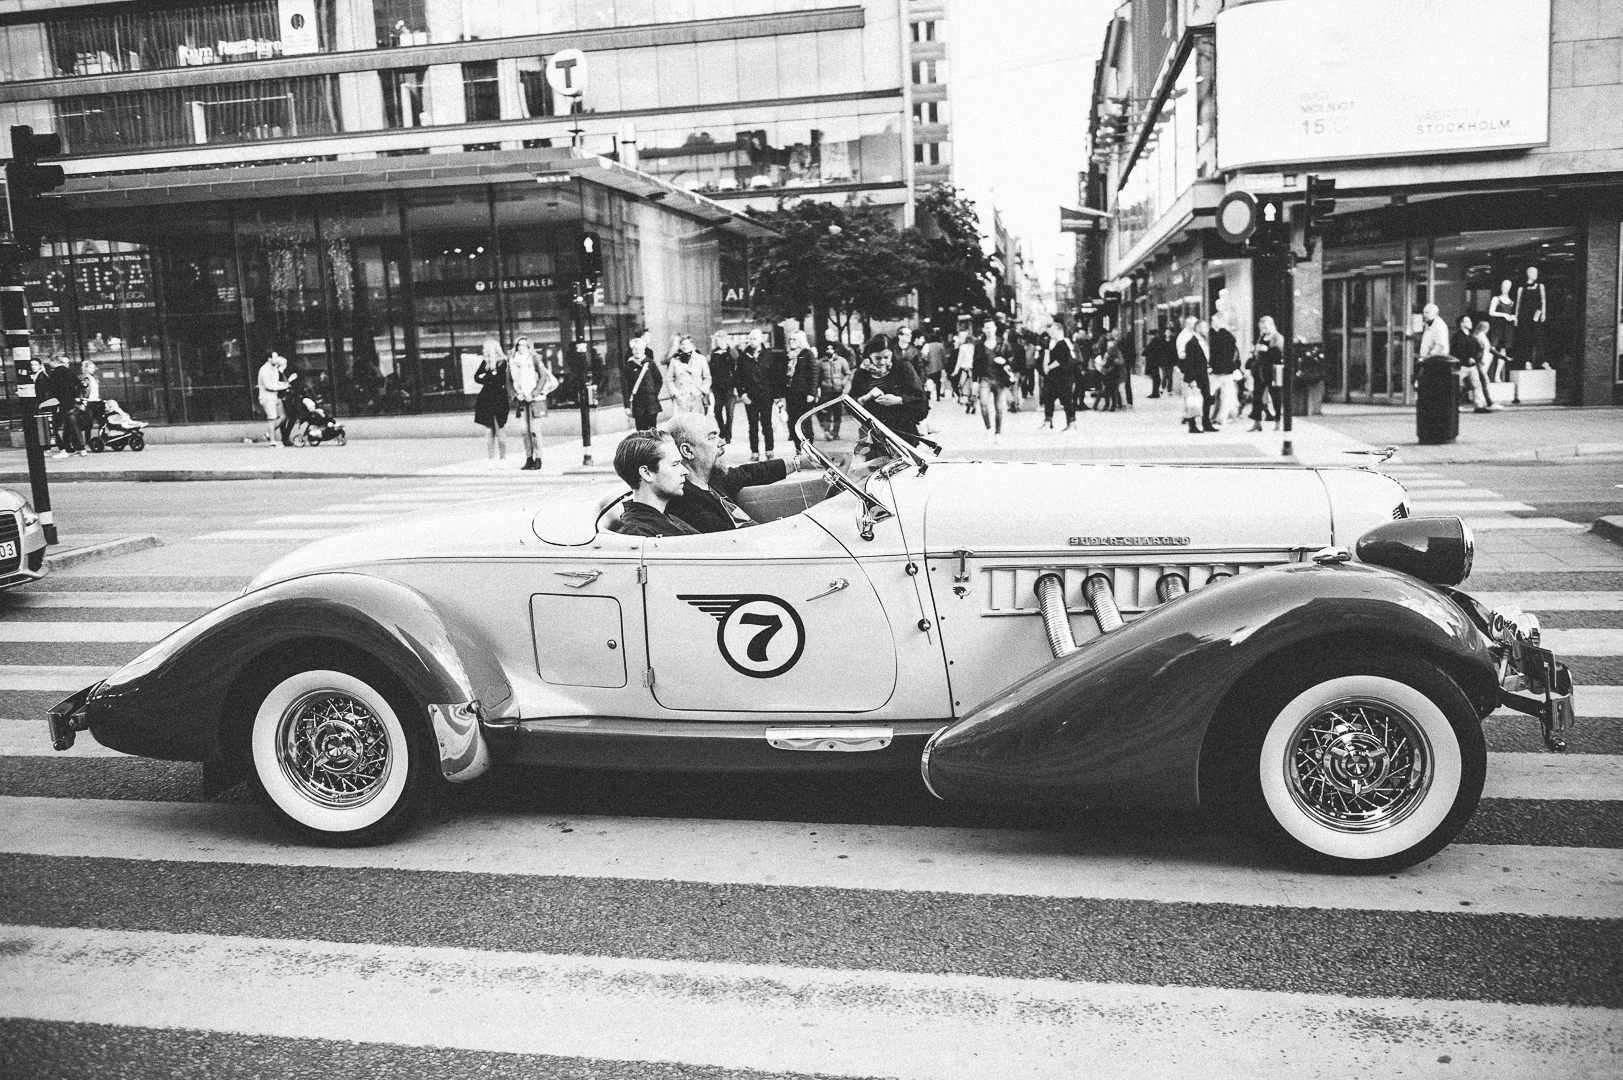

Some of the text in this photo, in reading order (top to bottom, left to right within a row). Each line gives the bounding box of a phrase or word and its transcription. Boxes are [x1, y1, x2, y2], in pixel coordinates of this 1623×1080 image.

[555, 58, 577, 89] T
[1416, 119, 1510, 135] STOCKHOLM
[1070, 537, 1189, 546] SUPER-CHARGED
[0, 543, 13, 557] 03
[739, 612, 783, 662] 7
